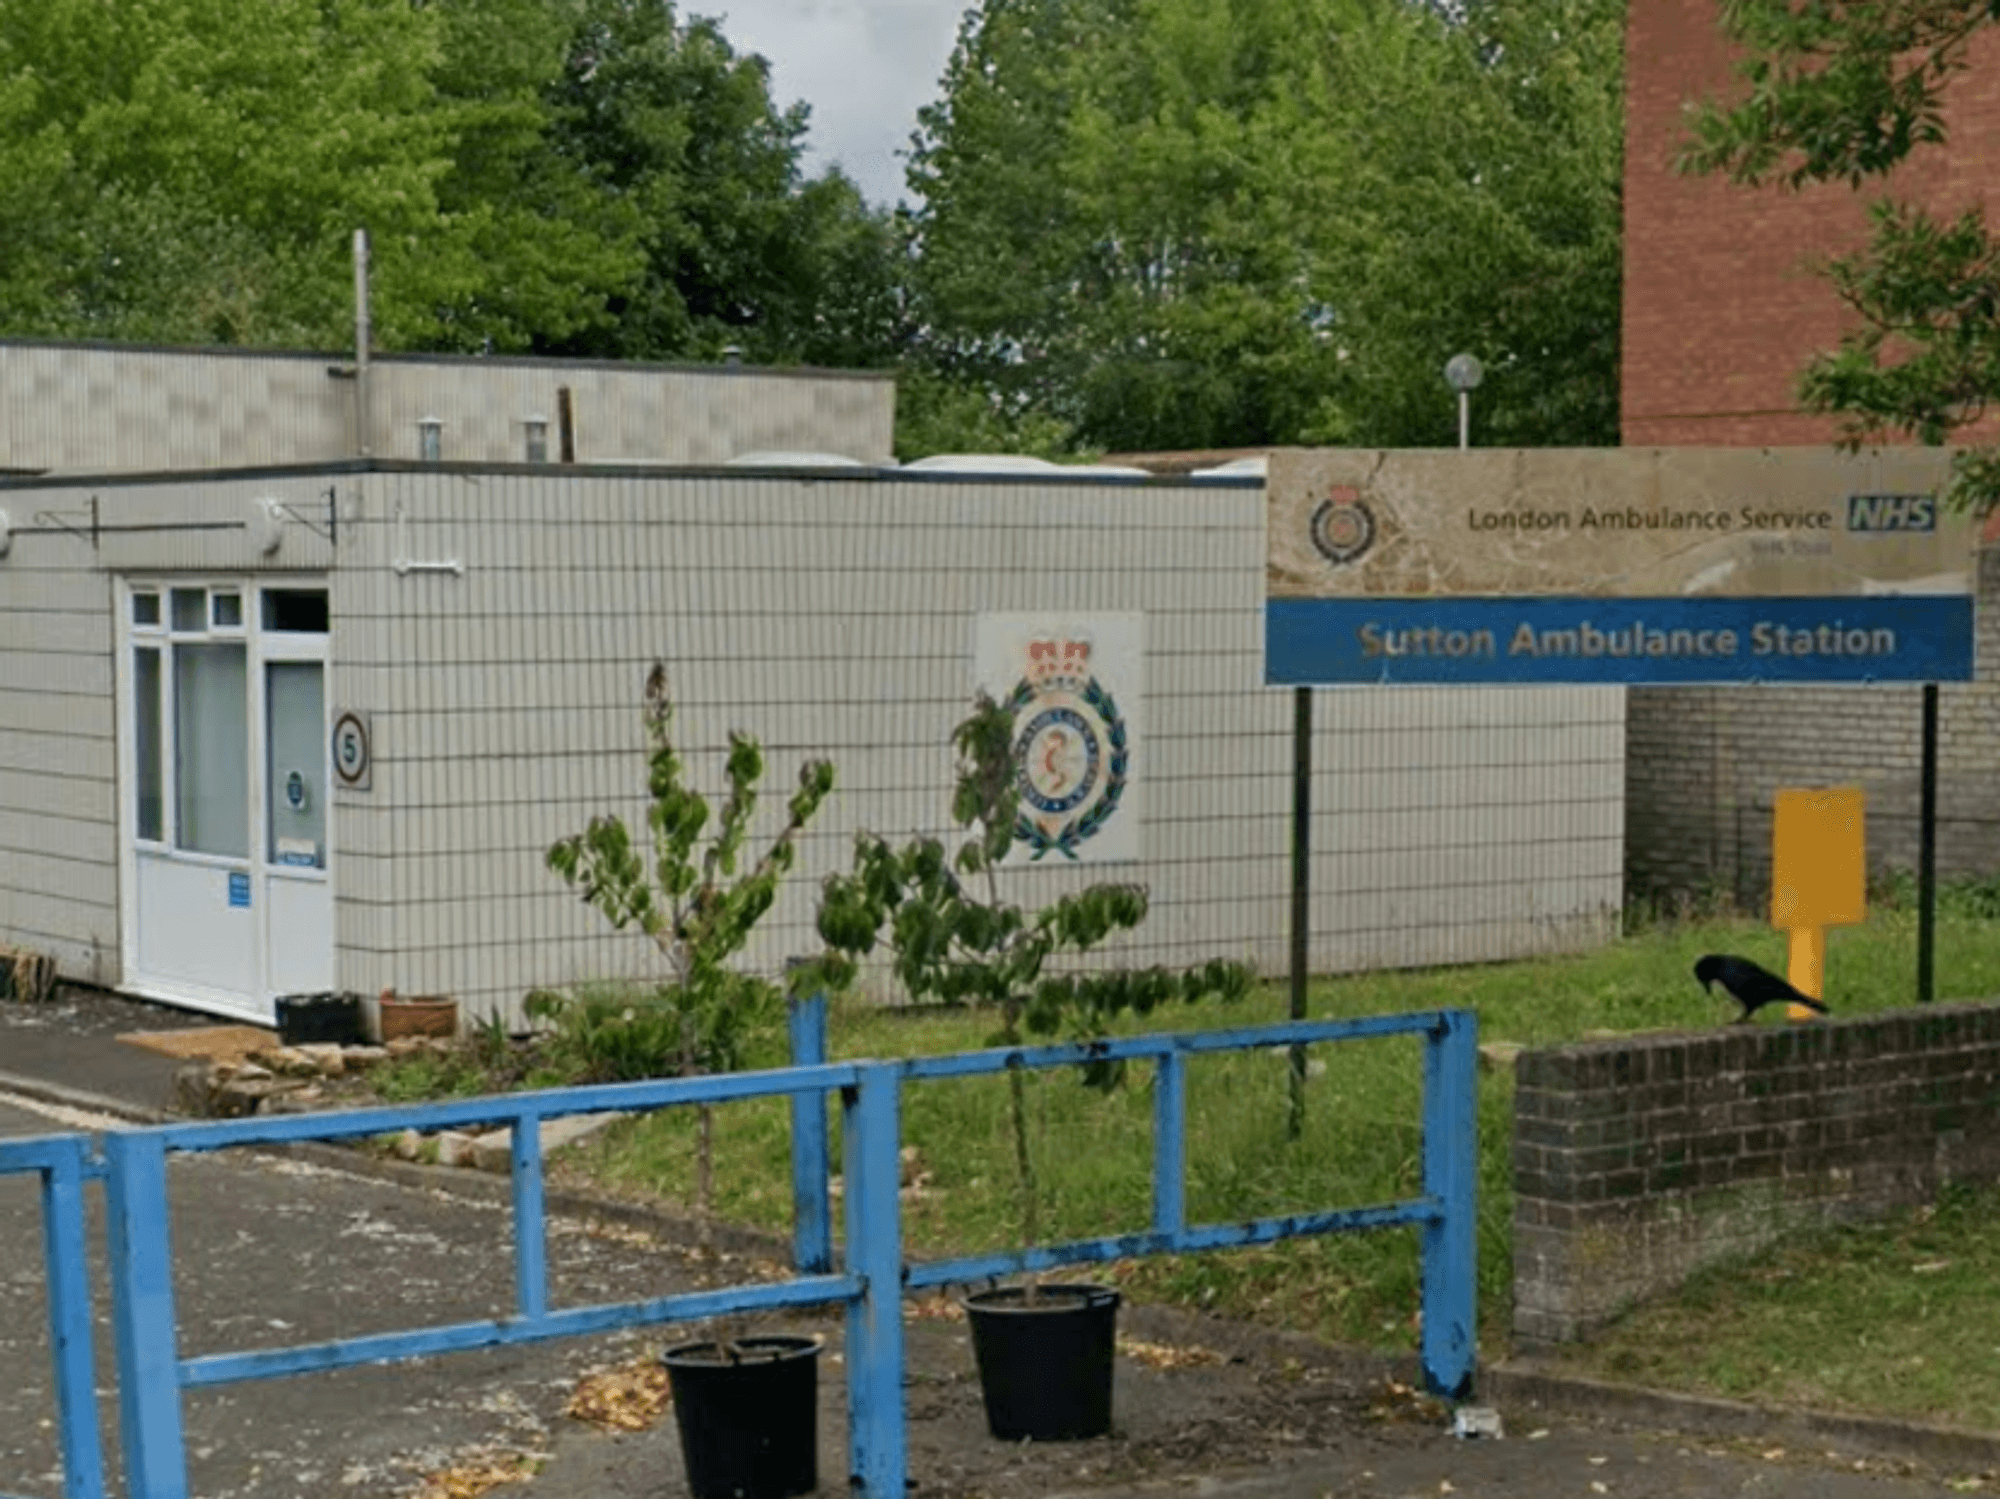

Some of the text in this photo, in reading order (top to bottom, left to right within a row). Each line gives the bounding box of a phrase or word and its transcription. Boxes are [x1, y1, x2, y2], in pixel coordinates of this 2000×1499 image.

[1469, 506, 1832, 532] London Ambulance Service
[1850, 498, 1933, 529] NHS
[1356, 619, 1895, 656] Sutton Ambulance Station
[344, 733, 356, 764] 5
